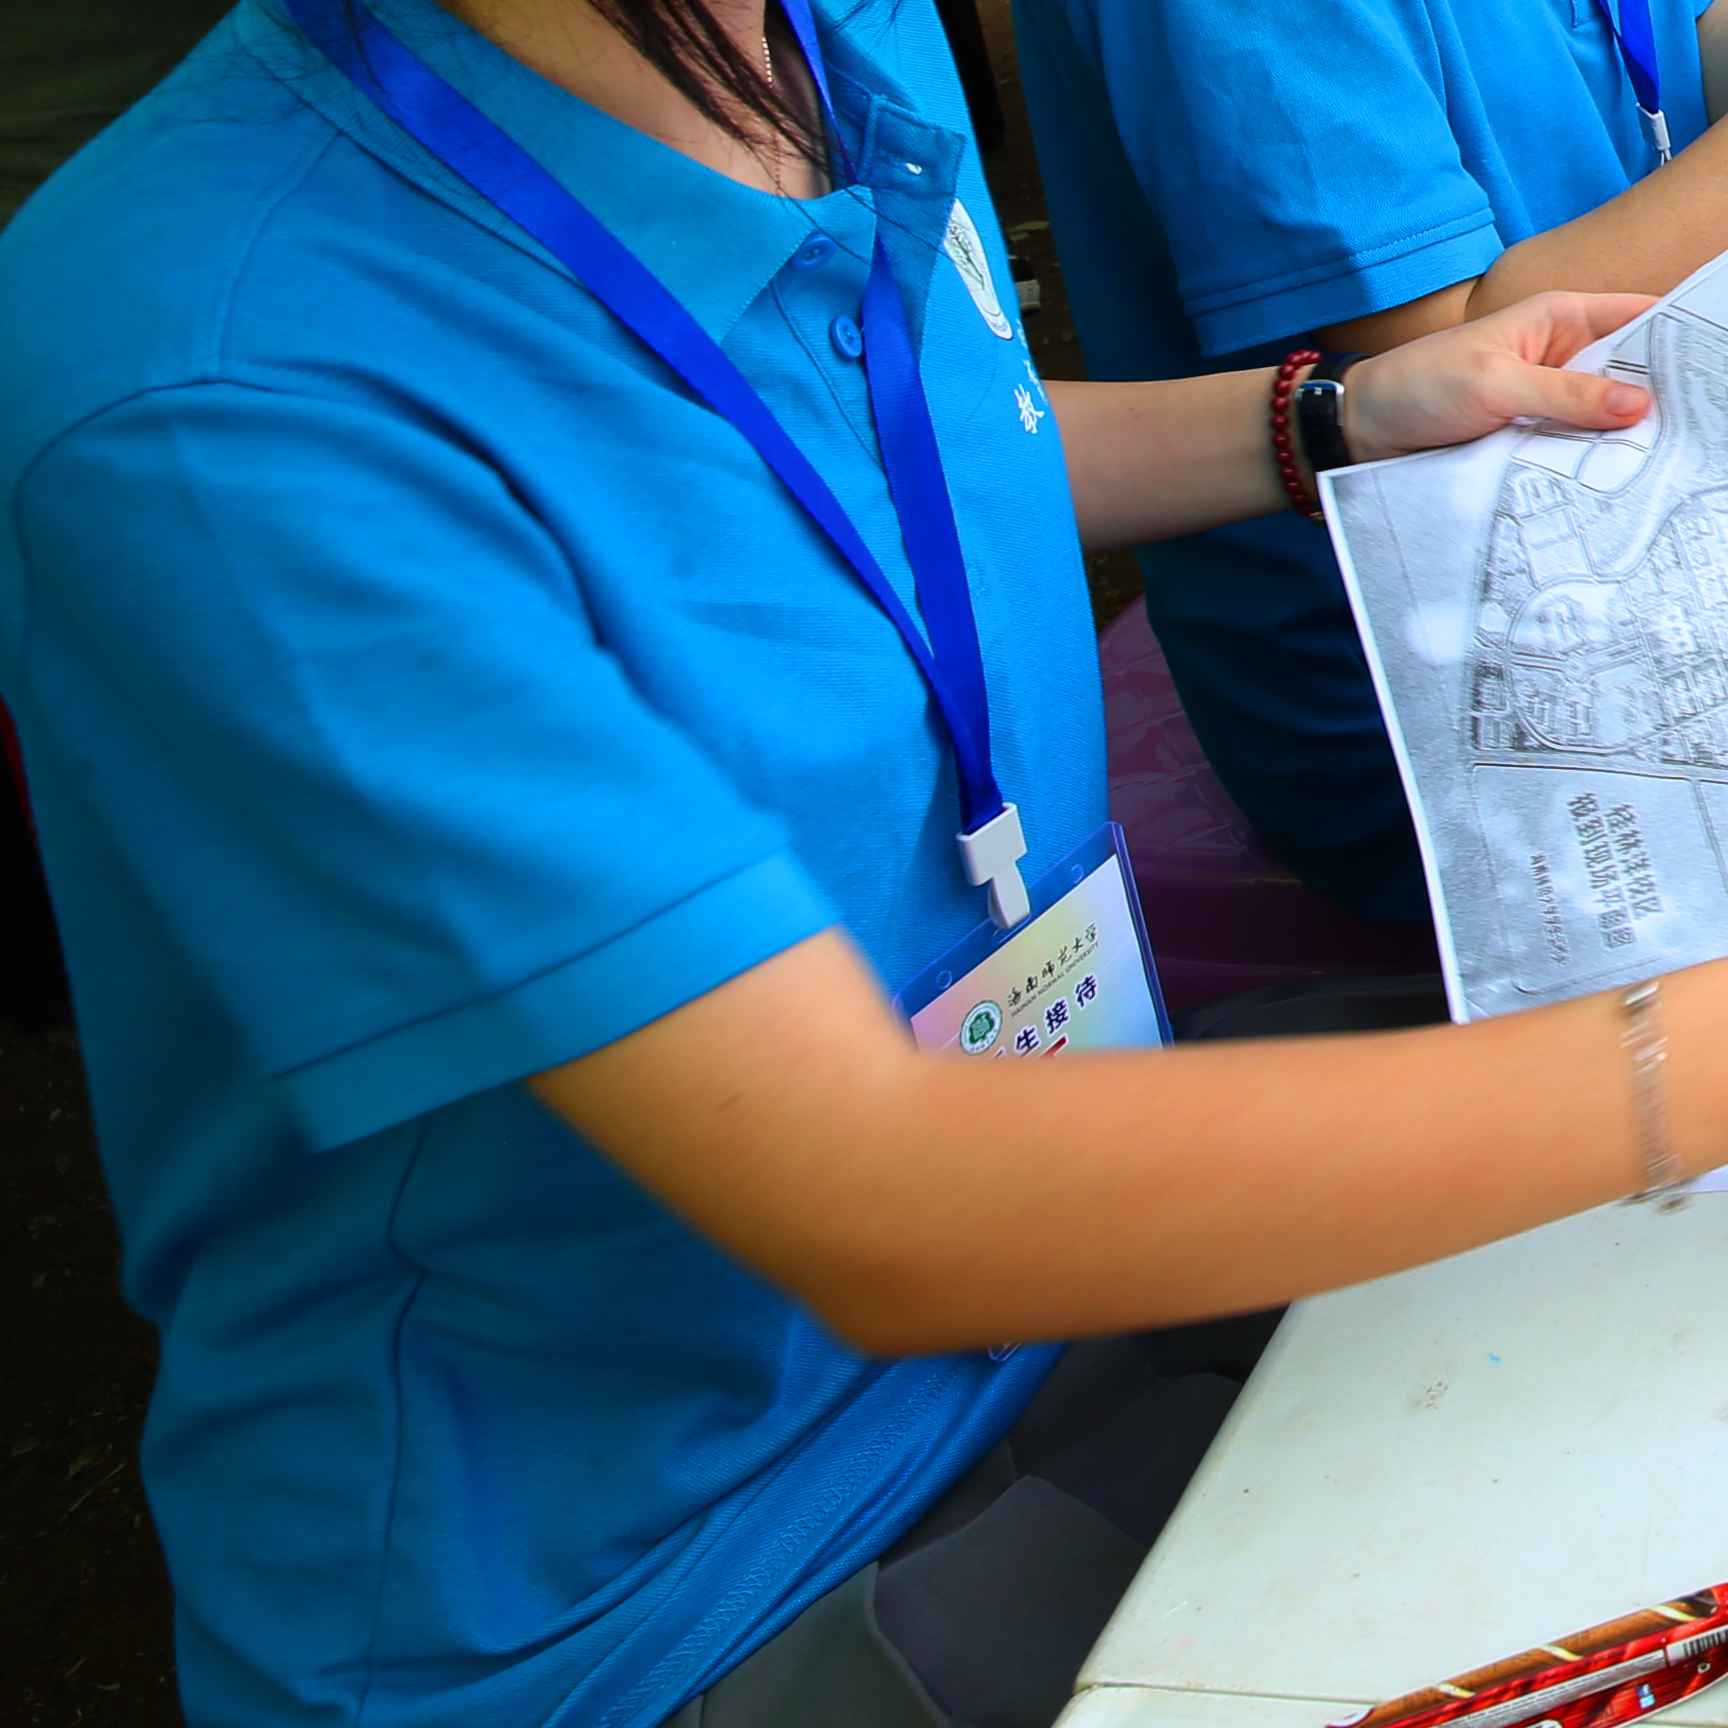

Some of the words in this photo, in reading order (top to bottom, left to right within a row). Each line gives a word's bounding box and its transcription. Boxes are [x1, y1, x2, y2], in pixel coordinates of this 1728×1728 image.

[1006, 922, 1099, 1009] 海南师范大学
[996, 974, 1098, 1060] 生接待
